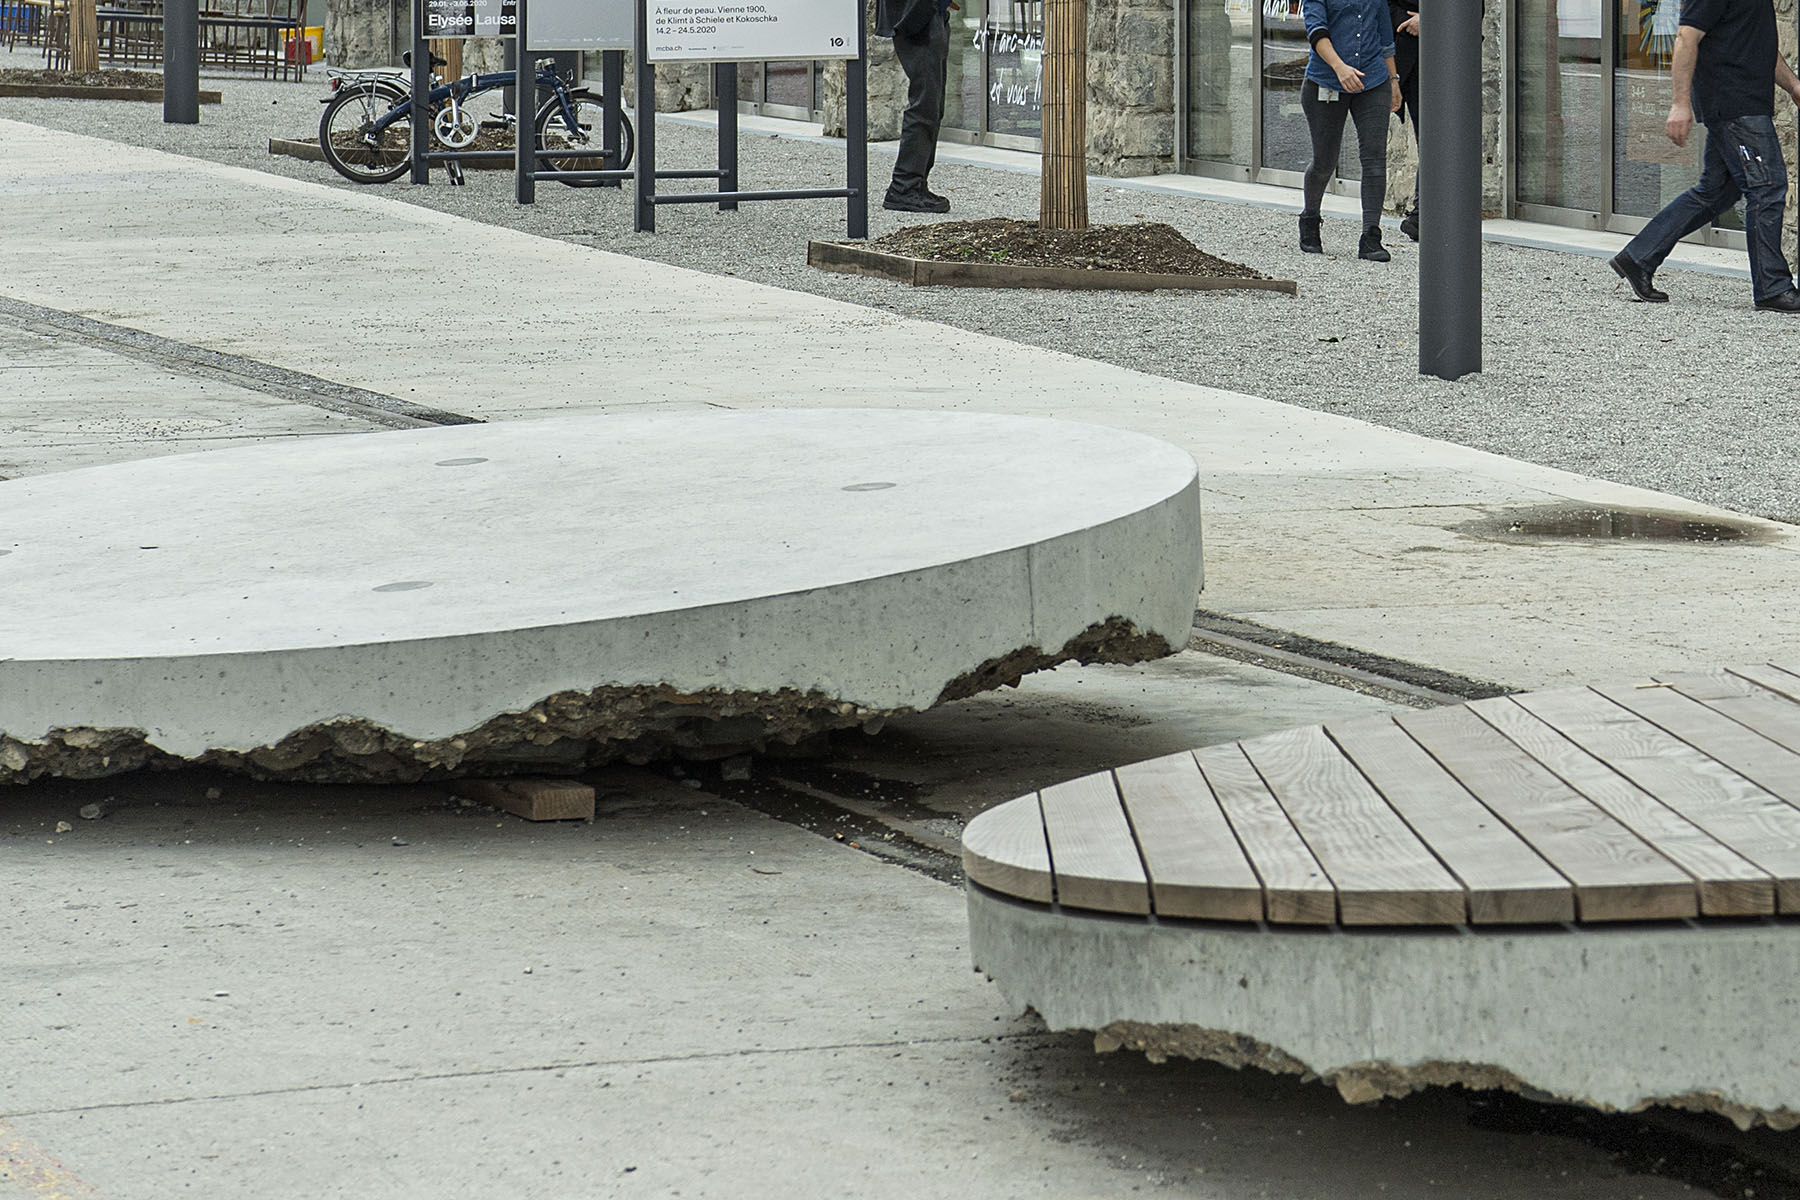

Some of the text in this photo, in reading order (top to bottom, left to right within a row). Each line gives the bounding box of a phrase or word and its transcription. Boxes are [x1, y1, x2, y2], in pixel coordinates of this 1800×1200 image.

[655, 5, 767, 16] À fleur de peau. Vienne 1900,
[428, 14, 516, 28] Elysée Lausa
[655, 14, 778, 25] de Klimt à Schiele et Kokoschka
[656, 27, 671, 35] 14.2
[678, 26, 717, 34] 24.5.2020
[1007, 84, 1028, 106] vous
